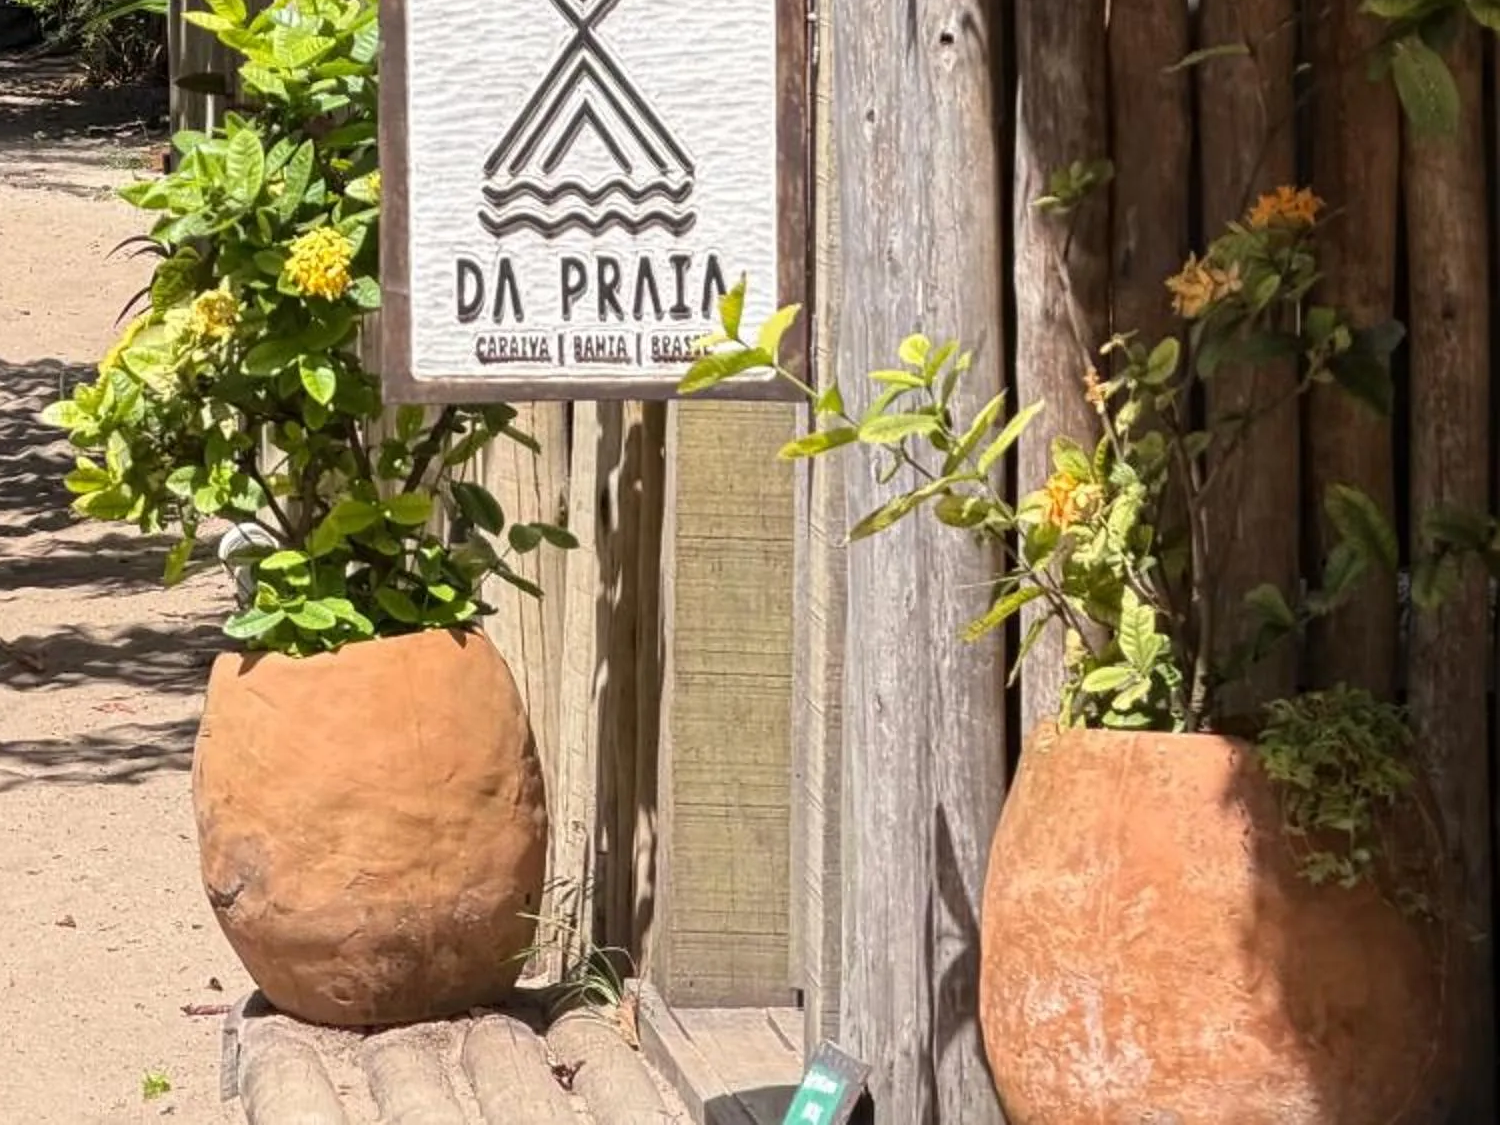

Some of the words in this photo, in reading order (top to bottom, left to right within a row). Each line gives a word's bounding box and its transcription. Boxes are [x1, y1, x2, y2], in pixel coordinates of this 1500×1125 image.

[456, 256, 525, 323] DA
[560, 253, 728, 321] PRAIA
[573, 335, 630, 361] BAHIA
